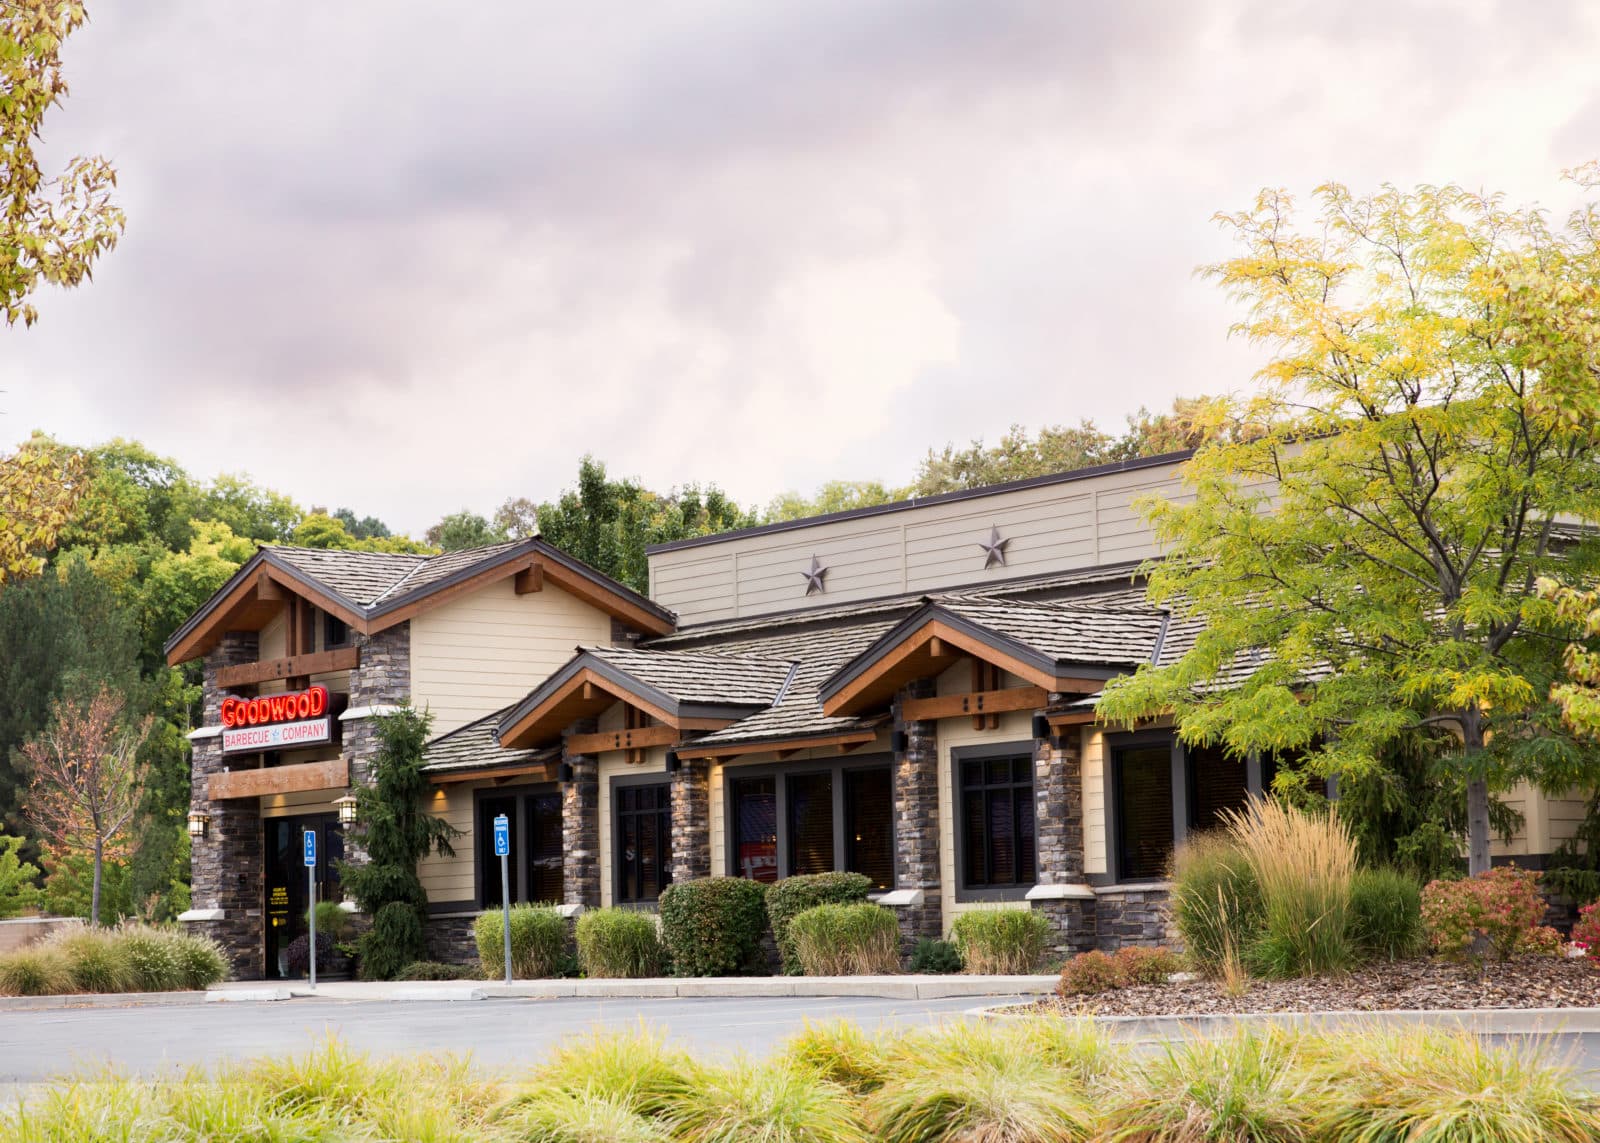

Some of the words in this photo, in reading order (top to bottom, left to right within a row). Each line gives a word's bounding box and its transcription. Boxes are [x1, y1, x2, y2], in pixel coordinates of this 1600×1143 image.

[222, 687, 323, 728] GOODWOOD
[225, 730, 270, 747] BARBECUE
[282, 723, 326, 740] COMPANY
